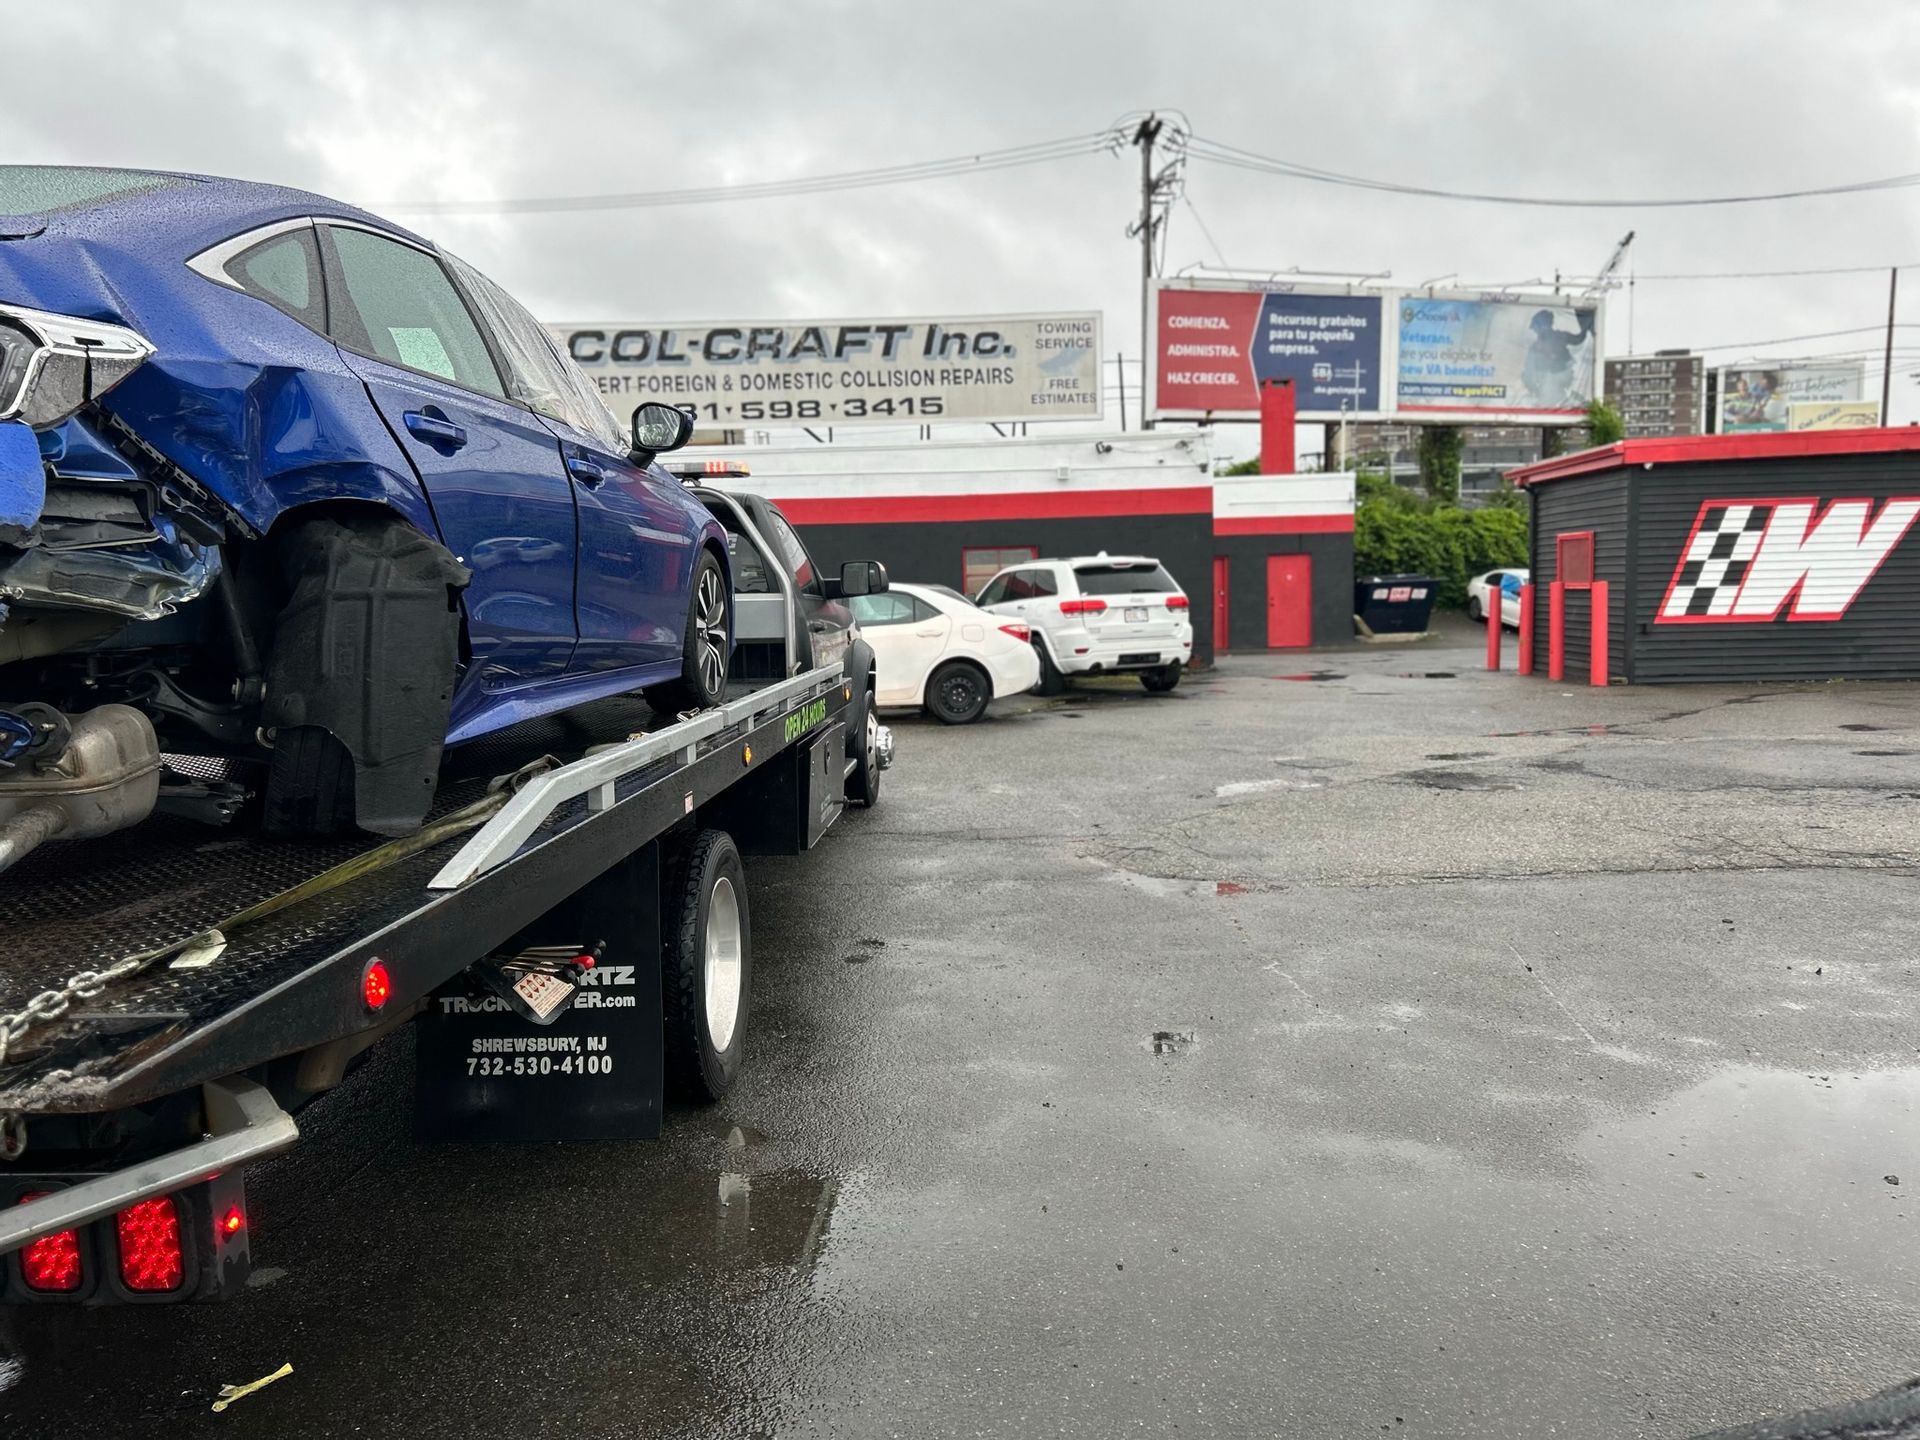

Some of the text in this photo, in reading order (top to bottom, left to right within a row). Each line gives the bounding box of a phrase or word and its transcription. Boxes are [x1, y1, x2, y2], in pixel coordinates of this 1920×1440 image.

[1168, 315, 1230, 329] COMIENZA.
[1270, 313, 1367, 329] Recursos gratuitos
[1036, 322, 1092, 335] TOWING
[1269, 328, 1355, 343] para tu pequeña
[568, 323, 1015, 364] COL-CRAFT Inc.
[1035, 337, 1094, 350] SERVICE
[1167, 343, 1240, 358] ADMINISTRA.
[1269, 343, 1319, 357] empresa.
[1418, 351, 1439, 361] you
[1440, 348, 1478, 362] eligible
[1400, 364, 1496, 377] new VA benefits?
[590, 366, 1015, 395] ERT FOREIGN & DOMESTIC COLLISION REPAIRS
[1049, 378, 1080, 390] FREE
[1167, 372, 1240, 385] HAZ CRECER.
[1031, 392, 1097, 405] ESTIMATES
[784, 698, 826, 743] OPEN 24 HOURS
[472, 1036, 607, 1054] SHREWSBURY, NJ
[466, 1055, 613, 1076] 732-530-4100
